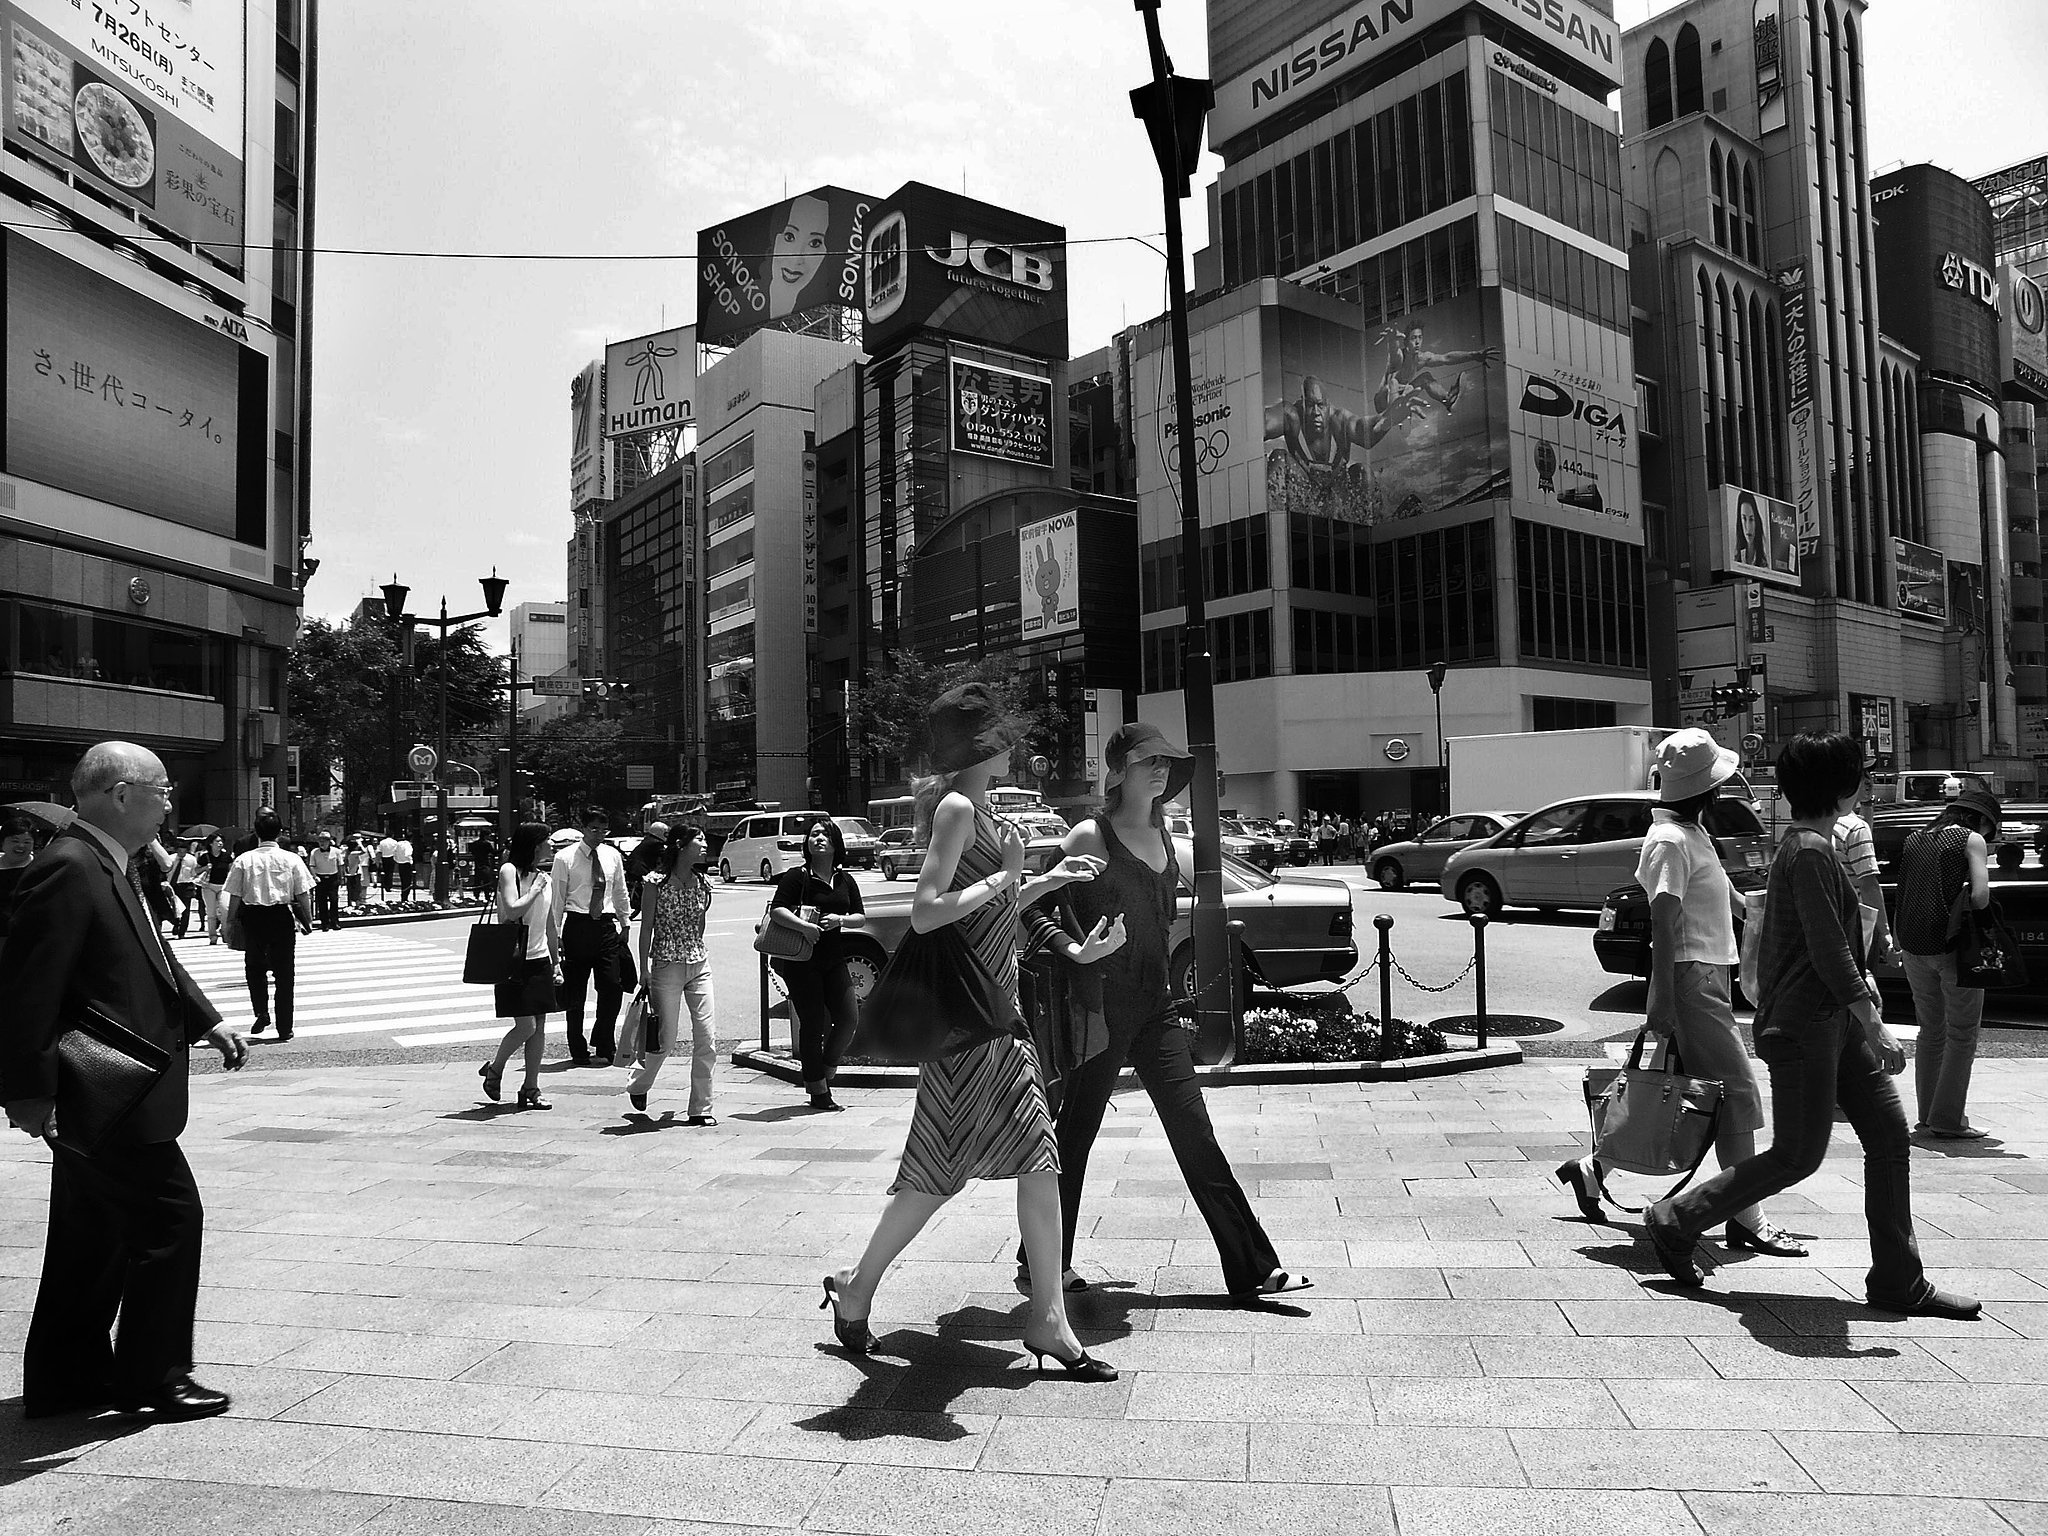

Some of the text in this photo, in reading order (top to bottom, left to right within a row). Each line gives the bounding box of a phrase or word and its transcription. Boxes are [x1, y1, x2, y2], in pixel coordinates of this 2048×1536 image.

[114, 0, 215, 70] フトセンター
[1251, 0, 1414, 109] NISSAN
[1504, 0, 1613, 64] SSAN
[91, 37, 179, 108] MITSUKOSHI
[1871, 183, 1905, 203] TDK
[712, 228, 766, 312] SONOKO
[839, 202, 871, 302] SONOKO
[924, 230, 1053, 290] JCB
[703, 263, 741, 316] SHOP
[611, 399, 692, 432] Human
[980, 404, 1047, 428] ダンディハウス
[1164, 403, 1231, 439] Pasonic
[1519, 375, 1627, 435] DIGA
[1596, 429, 1628, 449] ディーガ
[1563, 459, 1583, 476] 443
[1048, 515, 1075, 534] NOVA
